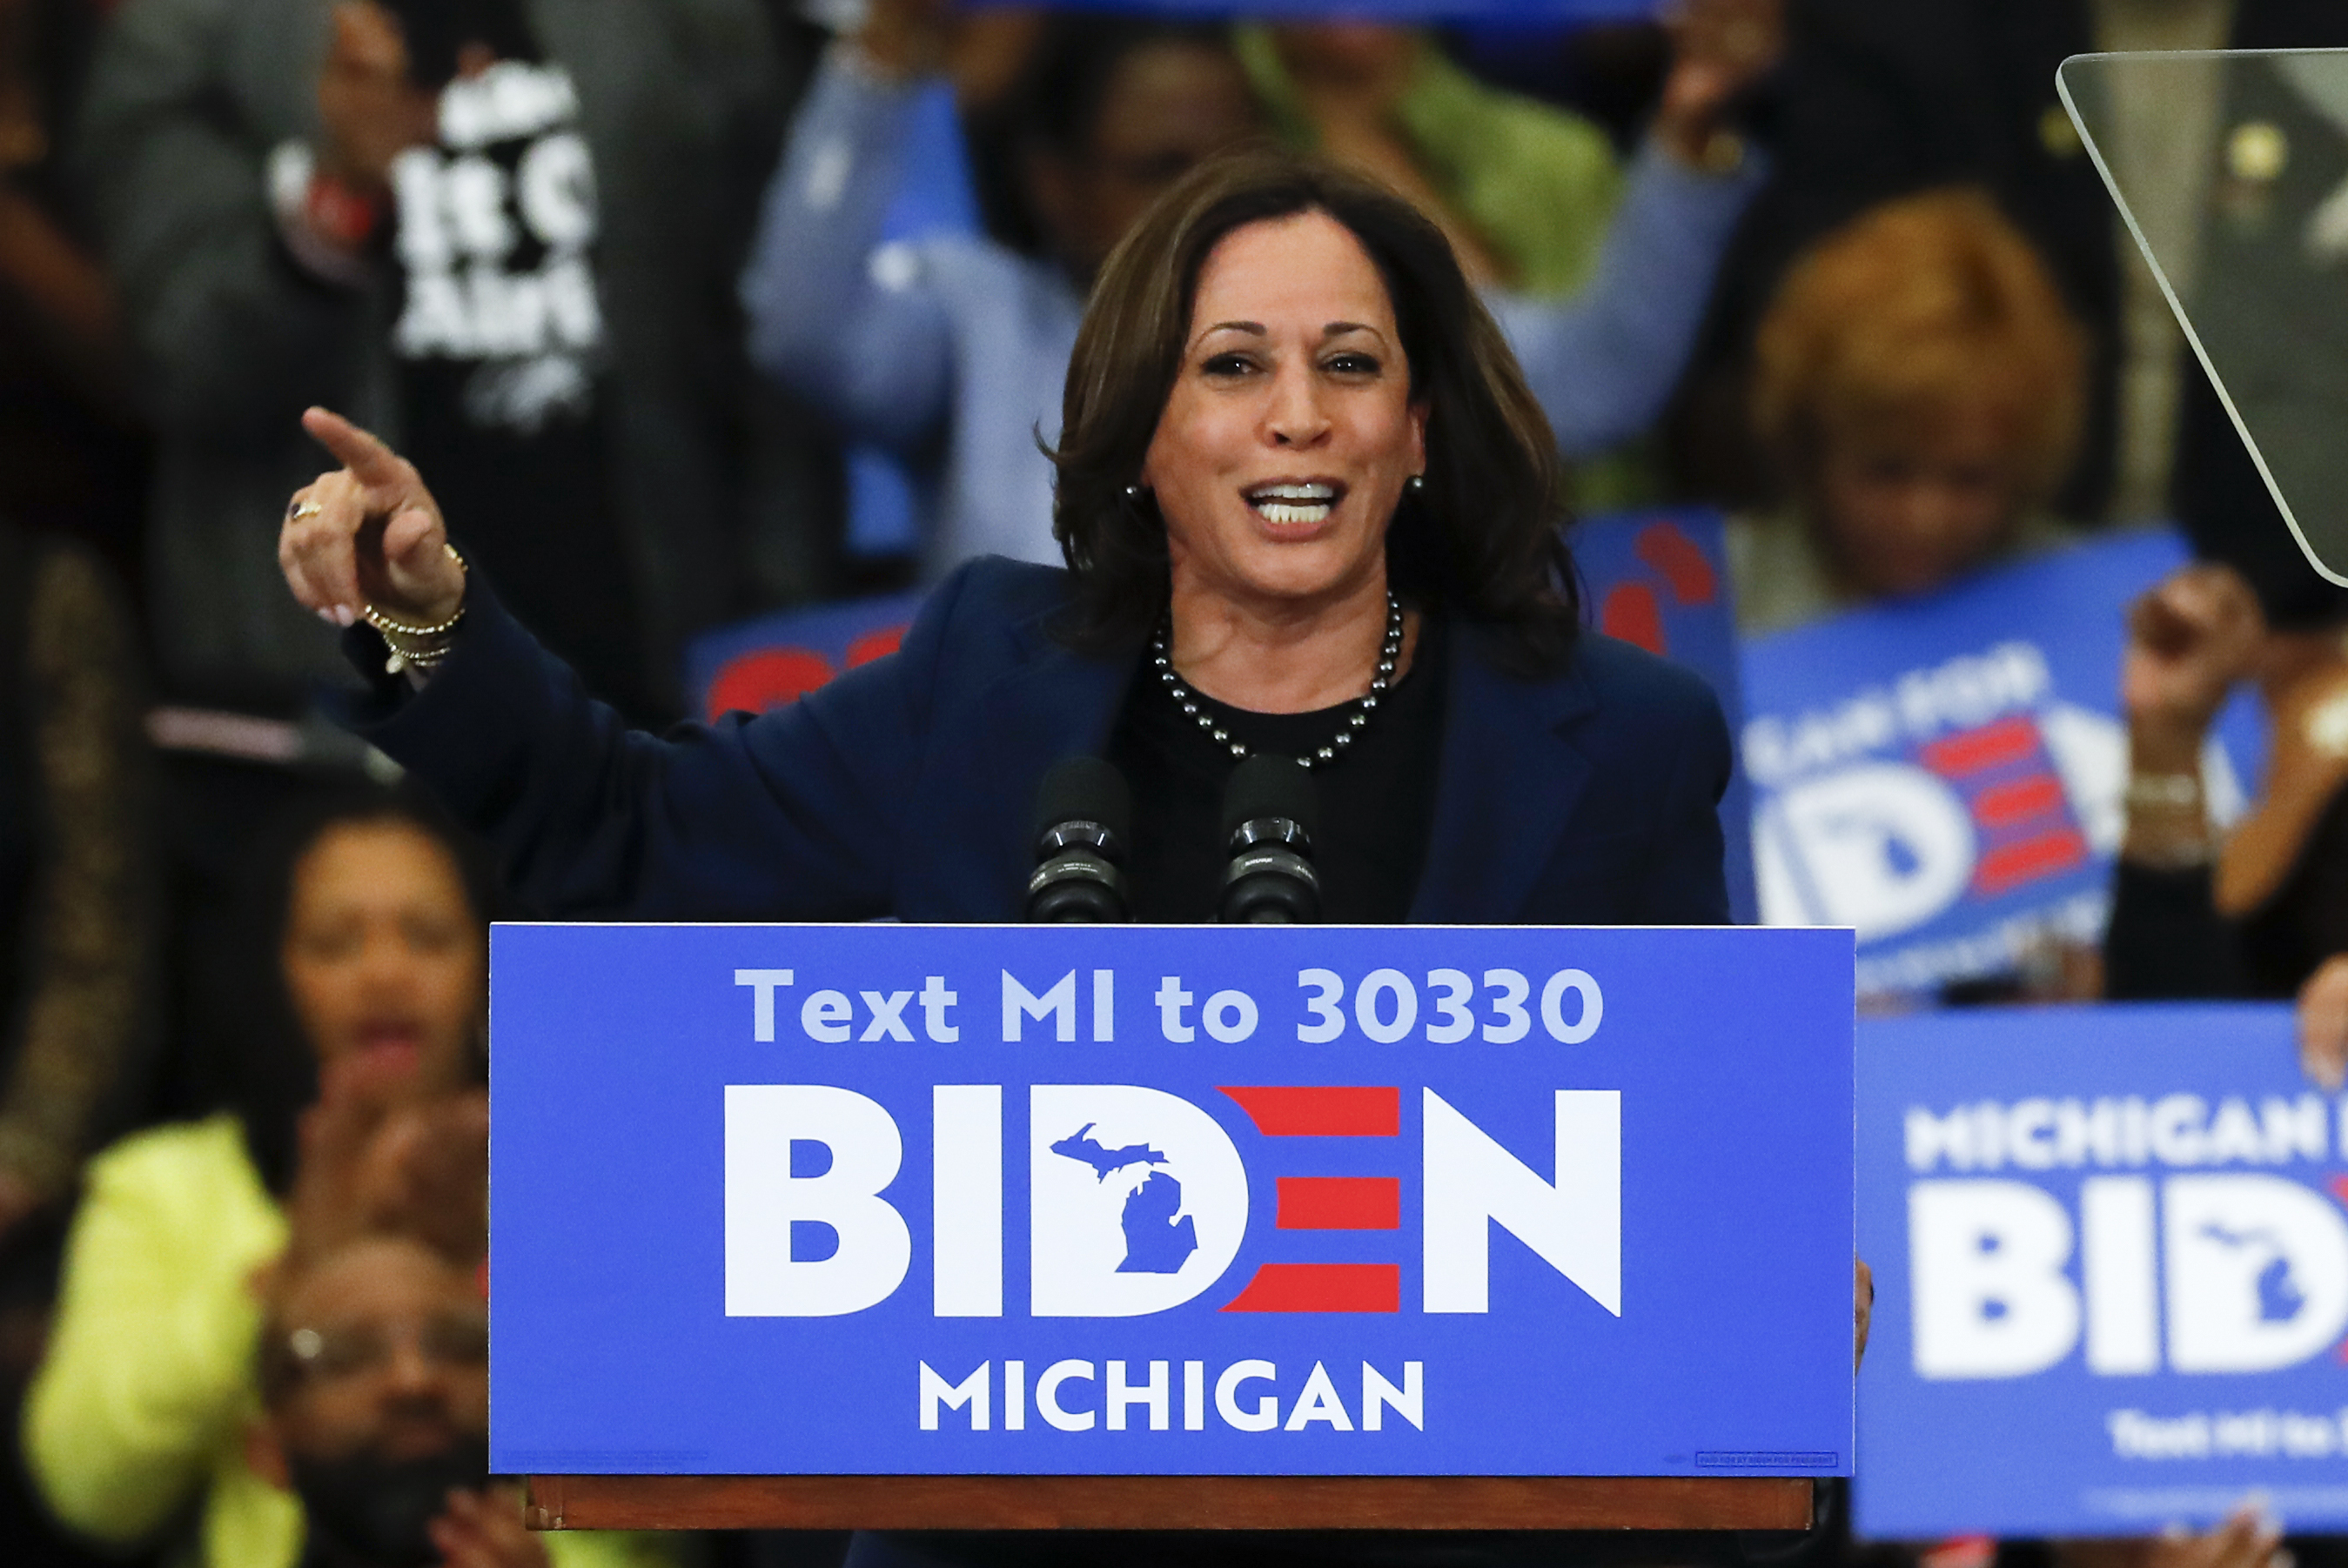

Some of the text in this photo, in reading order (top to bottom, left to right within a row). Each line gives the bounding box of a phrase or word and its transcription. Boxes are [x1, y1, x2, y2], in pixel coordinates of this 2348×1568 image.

[735, 968, 1604, 1044] Text MI to 30330
[1906, 1094, 2329, 1170] MICHIGAN
[724, 1084, 1622, 1318] BIDEN
[1909, 1174, 2348, 1380] BID
[919, 1359, 1424, 1432] MICHIGAN
